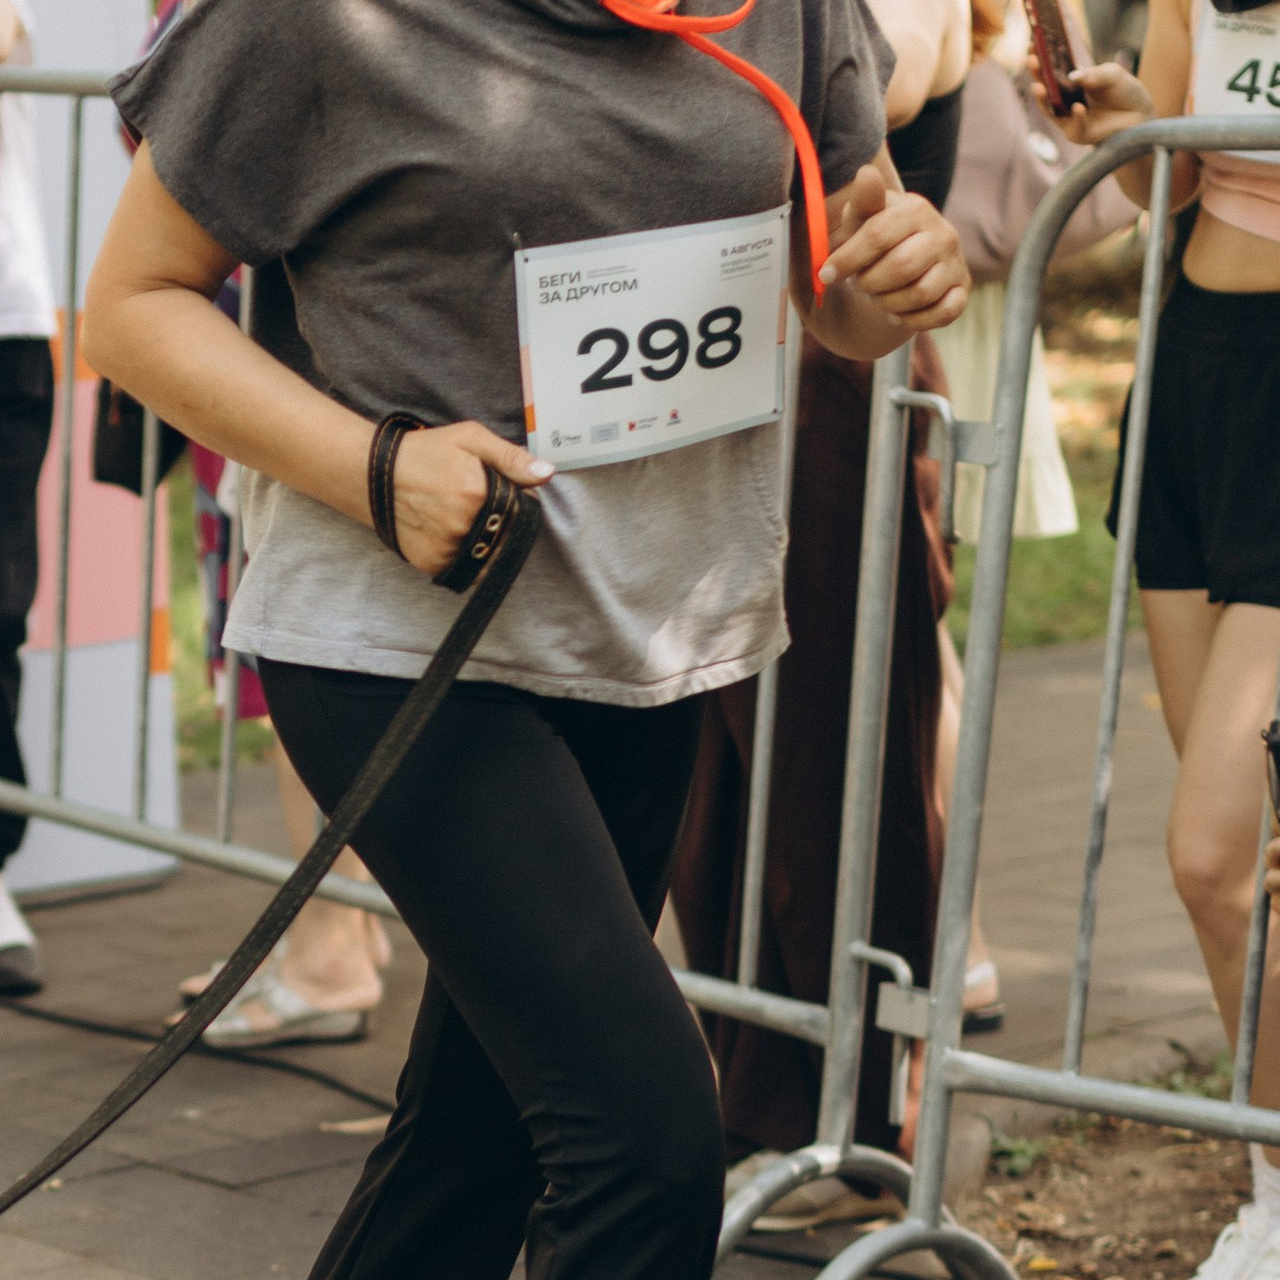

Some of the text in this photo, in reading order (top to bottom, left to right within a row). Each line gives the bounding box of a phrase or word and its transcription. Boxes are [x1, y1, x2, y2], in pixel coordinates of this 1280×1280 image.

[730, 237, 773, 255] АВГУСТА
[539, 270, 581, 289] БЕГИ
[539, 278, 638, 304] ЗА ДРУГОМ
[576, 305, 742, 395] 298
